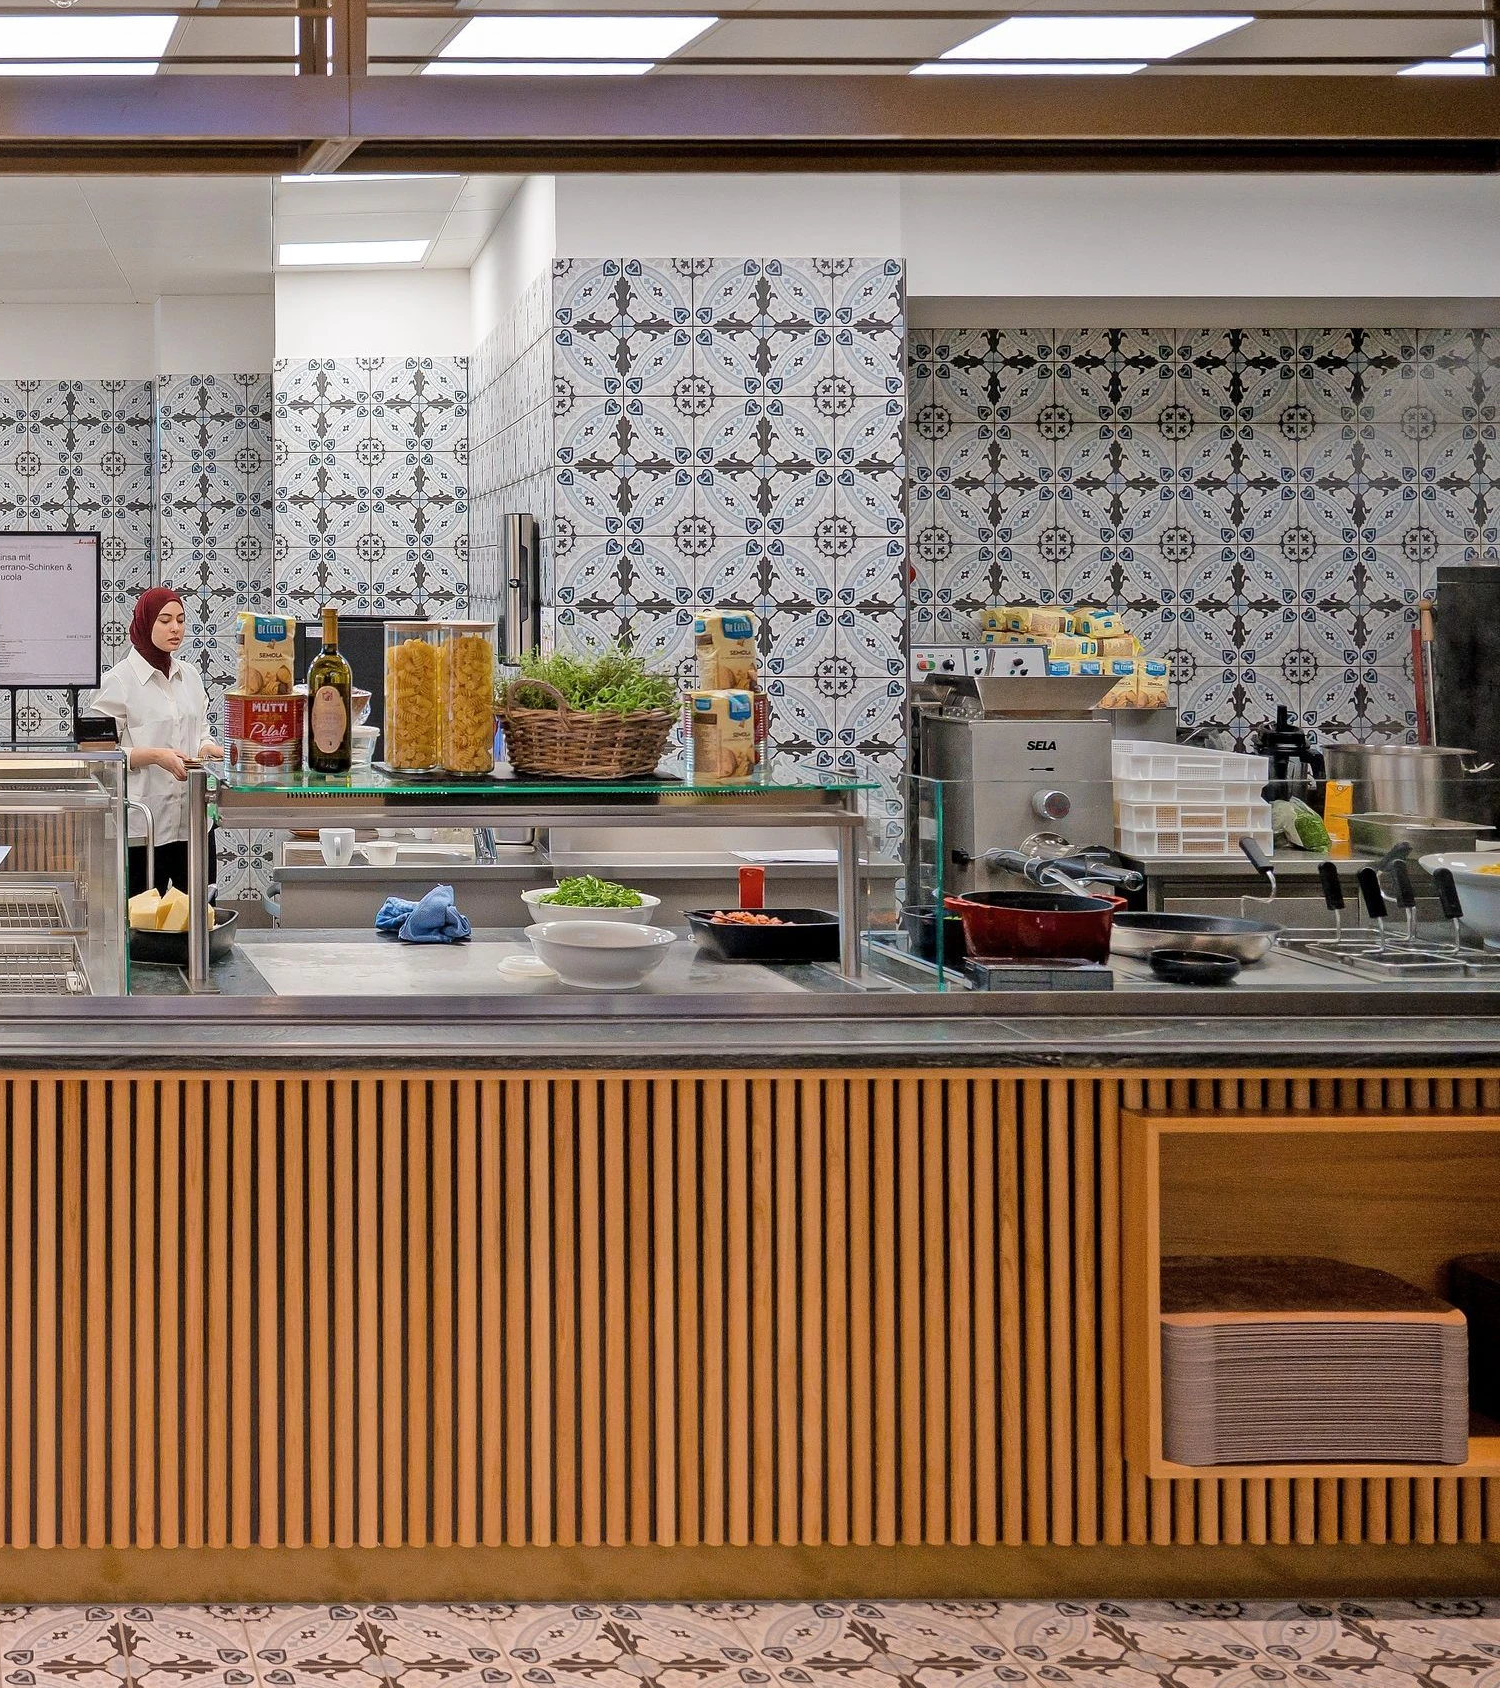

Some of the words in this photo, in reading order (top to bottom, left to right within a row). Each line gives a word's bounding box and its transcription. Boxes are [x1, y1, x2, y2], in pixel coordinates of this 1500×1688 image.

[19, 553, 31, 561] mit
[66, 563, 73, 571] &
[252, 702, 288, 713] MUTTI
[249, 721, 289, 739] Pelati
[1026, 740, 1057, 751] SELA
